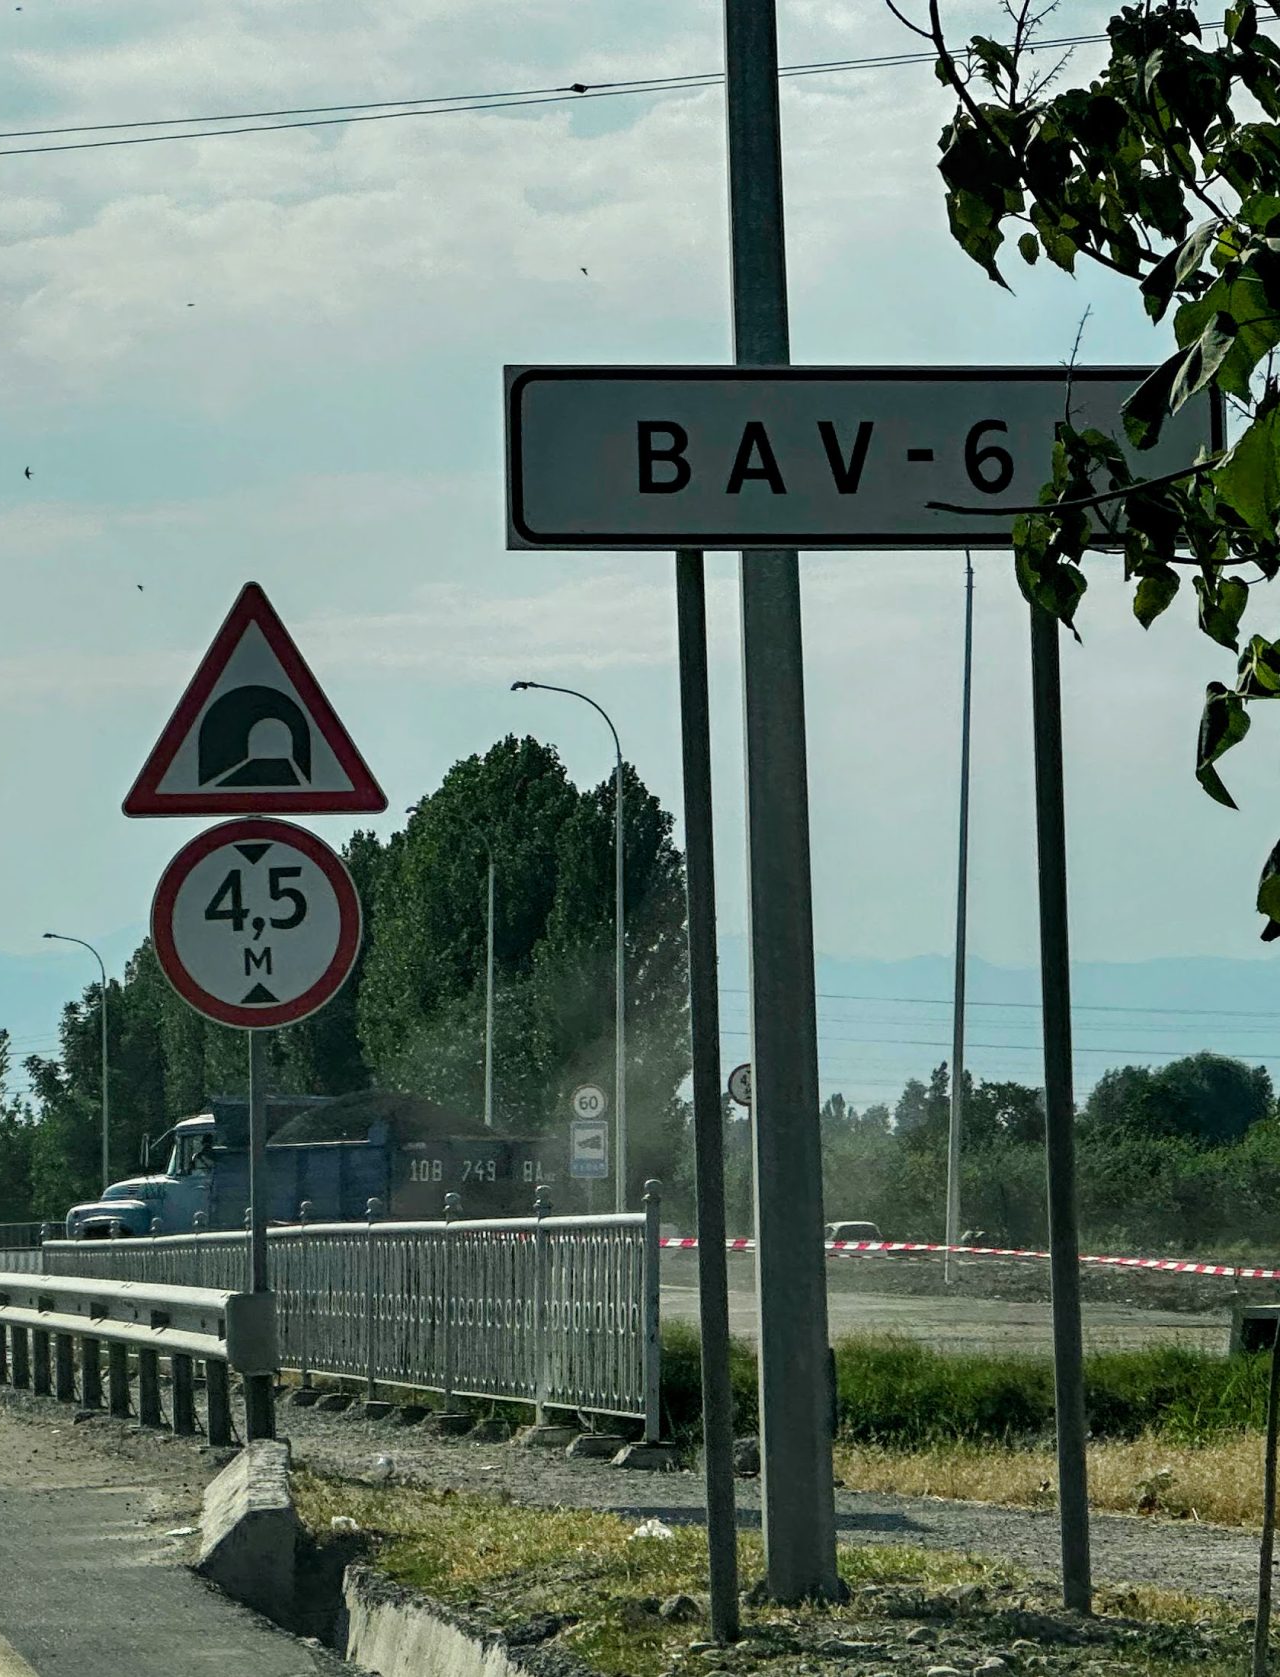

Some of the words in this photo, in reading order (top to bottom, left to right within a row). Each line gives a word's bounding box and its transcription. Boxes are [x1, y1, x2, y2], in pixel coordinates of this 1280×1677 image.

[636, 419, 1098, 496] BAV-6
[204, 866, 308, 941] 4,5
[243, 946, 273, 977] M
[579, 1095, 599, 1111] 60
